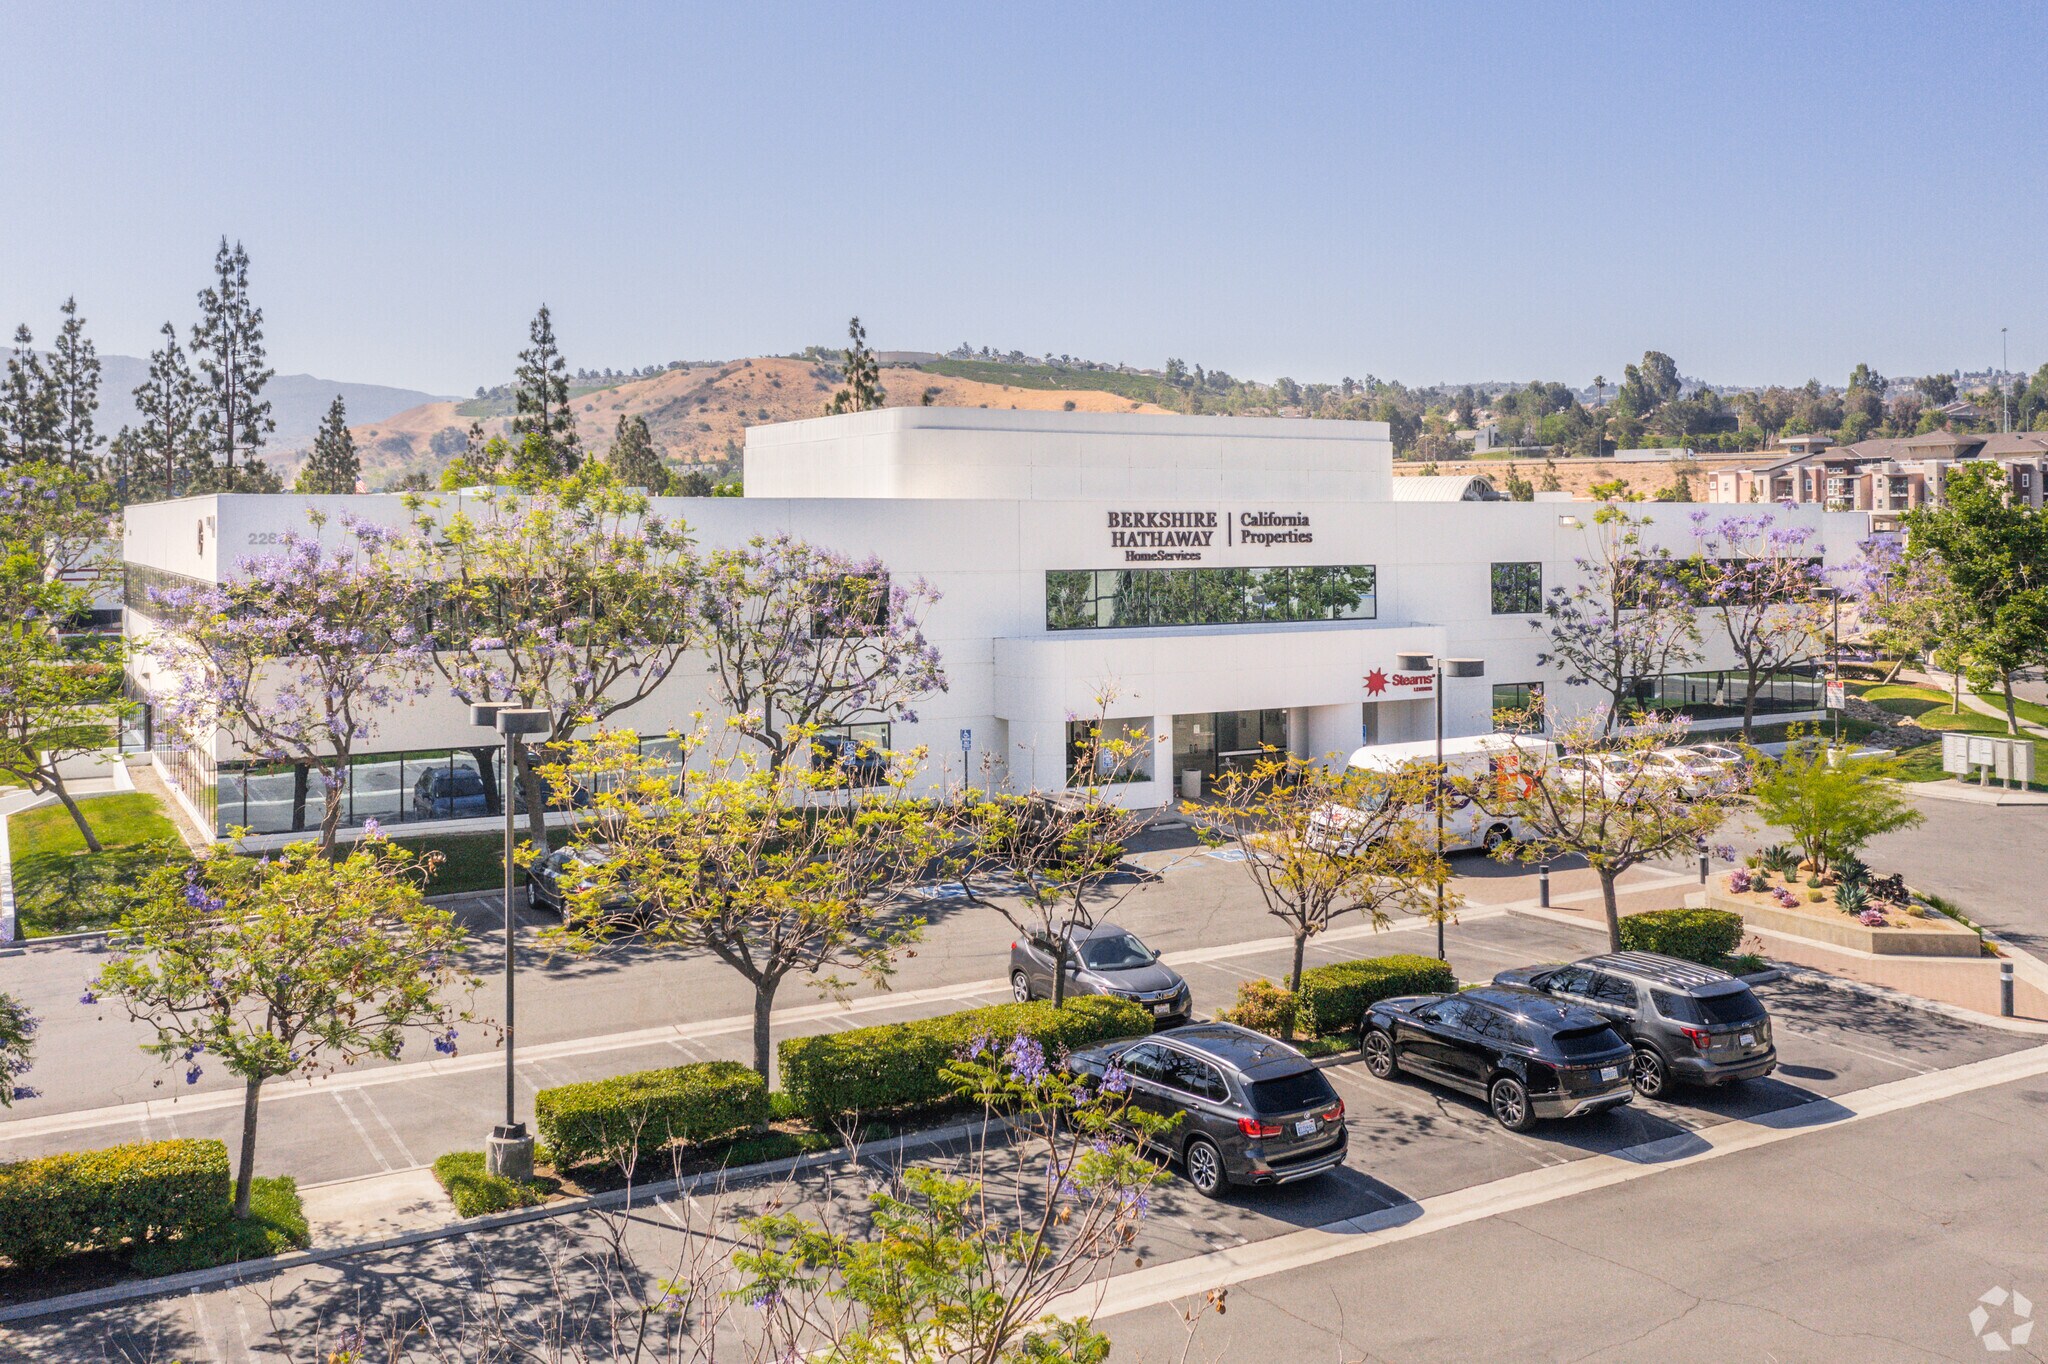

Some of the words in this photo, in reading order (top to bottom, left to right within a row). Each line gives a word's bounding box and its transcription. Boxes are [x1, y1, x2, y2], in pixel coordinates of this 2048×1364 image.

[1107, 511, 1218, 528] BERKSHIRE
[1240, 511, 1310, 527] California
[1111, 531, 1214, 548] HATHAWAY
[1240, 528, 1313, 547] Properties
[1125, 549, 1201, 562] HomeServices
